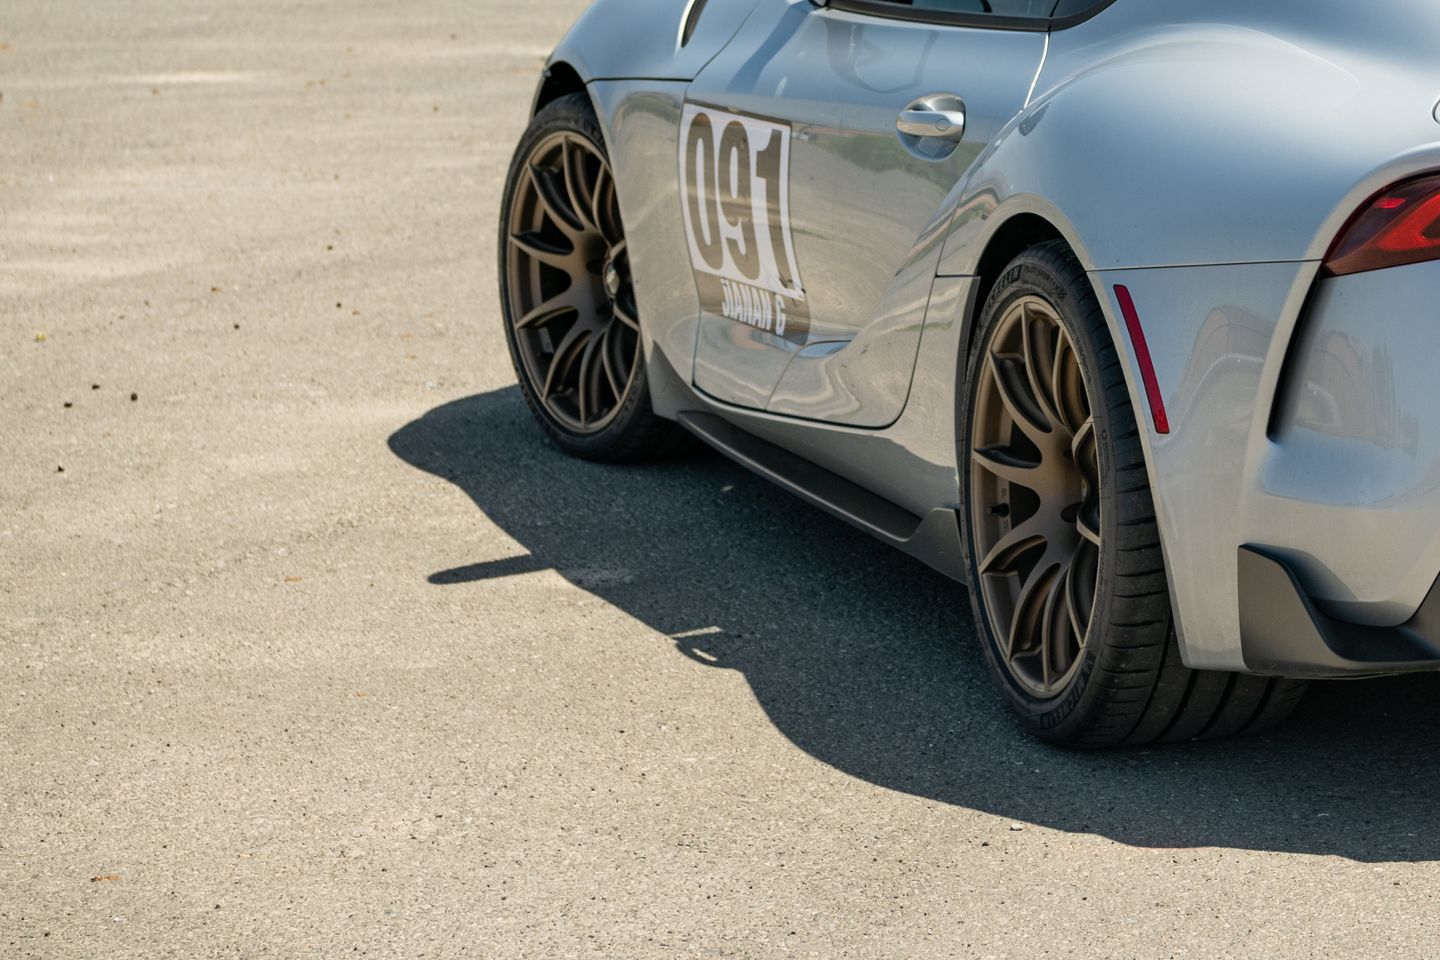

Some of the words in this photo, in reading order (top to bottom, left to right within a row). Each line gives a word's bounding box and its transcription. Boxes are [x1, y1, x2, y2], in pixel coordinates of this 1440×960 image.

[685, 112, 792, 289] 091
[721, 278, 772, 331] JIANAN
[775, 293, 786, 336] G
